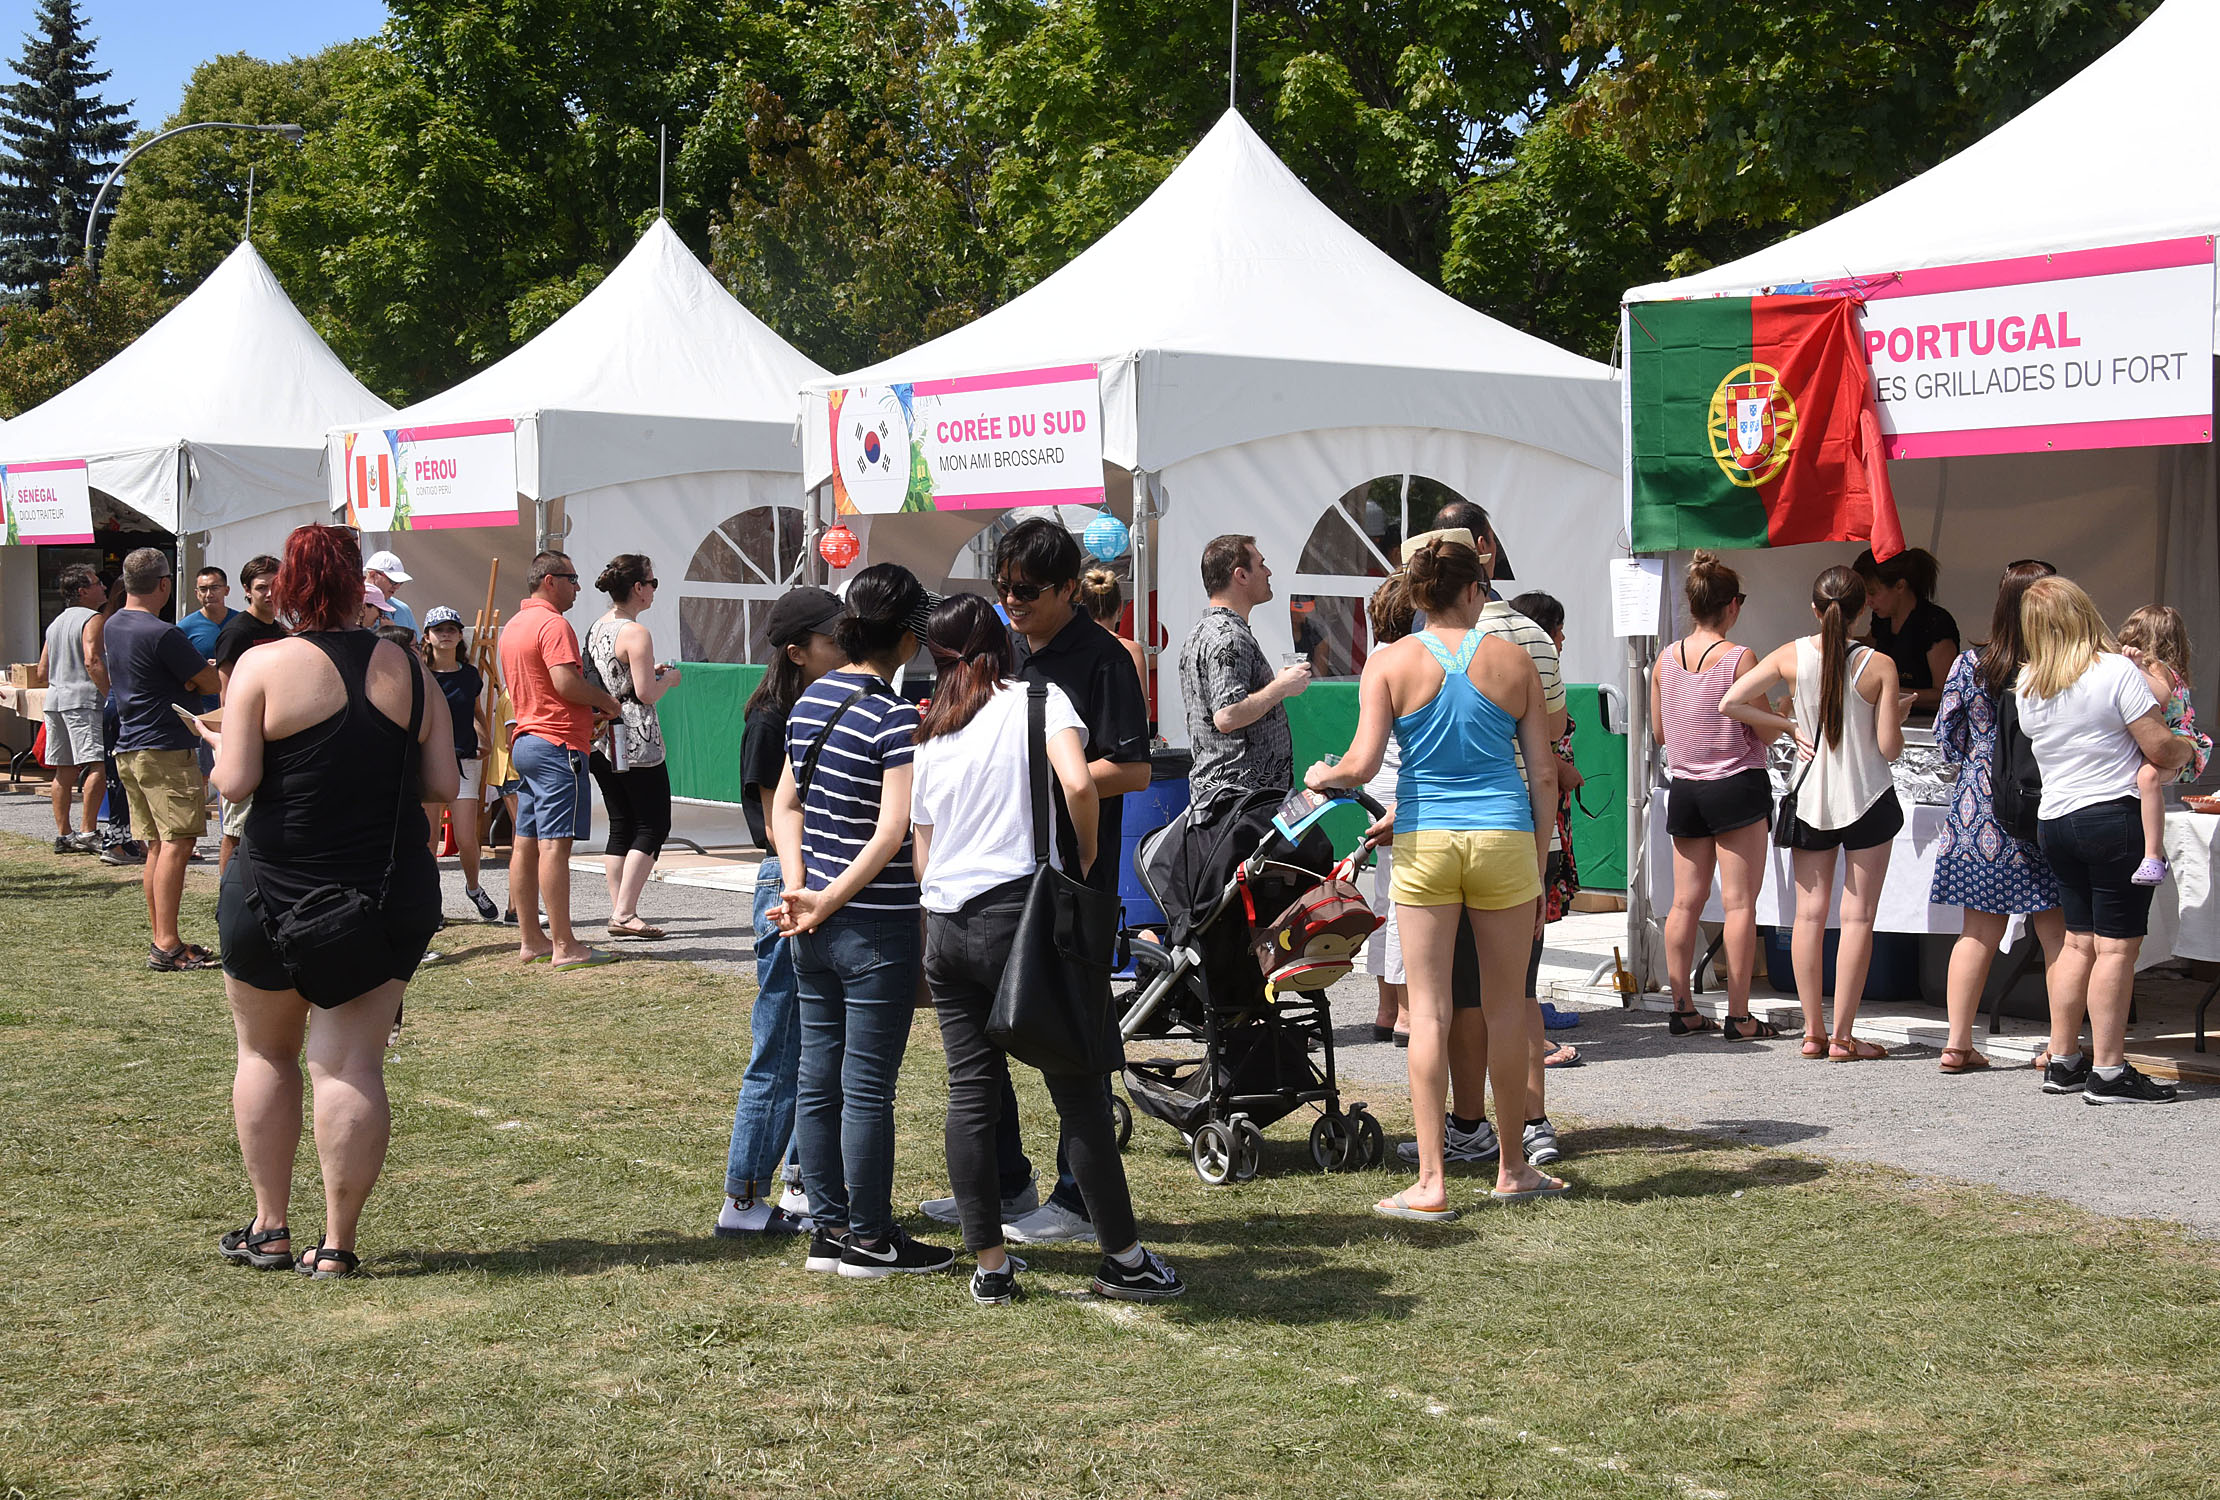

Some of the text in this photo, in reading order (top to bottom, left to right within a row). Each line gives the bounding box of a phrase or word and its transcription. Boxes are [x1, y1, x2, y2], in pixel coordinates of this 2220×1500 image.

[1864, 311, 2081, 366] PORTUGAL
[1873, 352, 2188, 403] ES GRILLADES DU FORT
[936, 409, 1086, 444] CORÉE DU SUD
[415, 455, 457, 481] PÉROU
[939, 447, 1065, 471] MON AMI BROSSARD
[18, 485, 58, 503] SÉNÉGAL
[415, 486, 438, 496] CONTIGO
[37, 509, 65, 520] TRAITEUR
